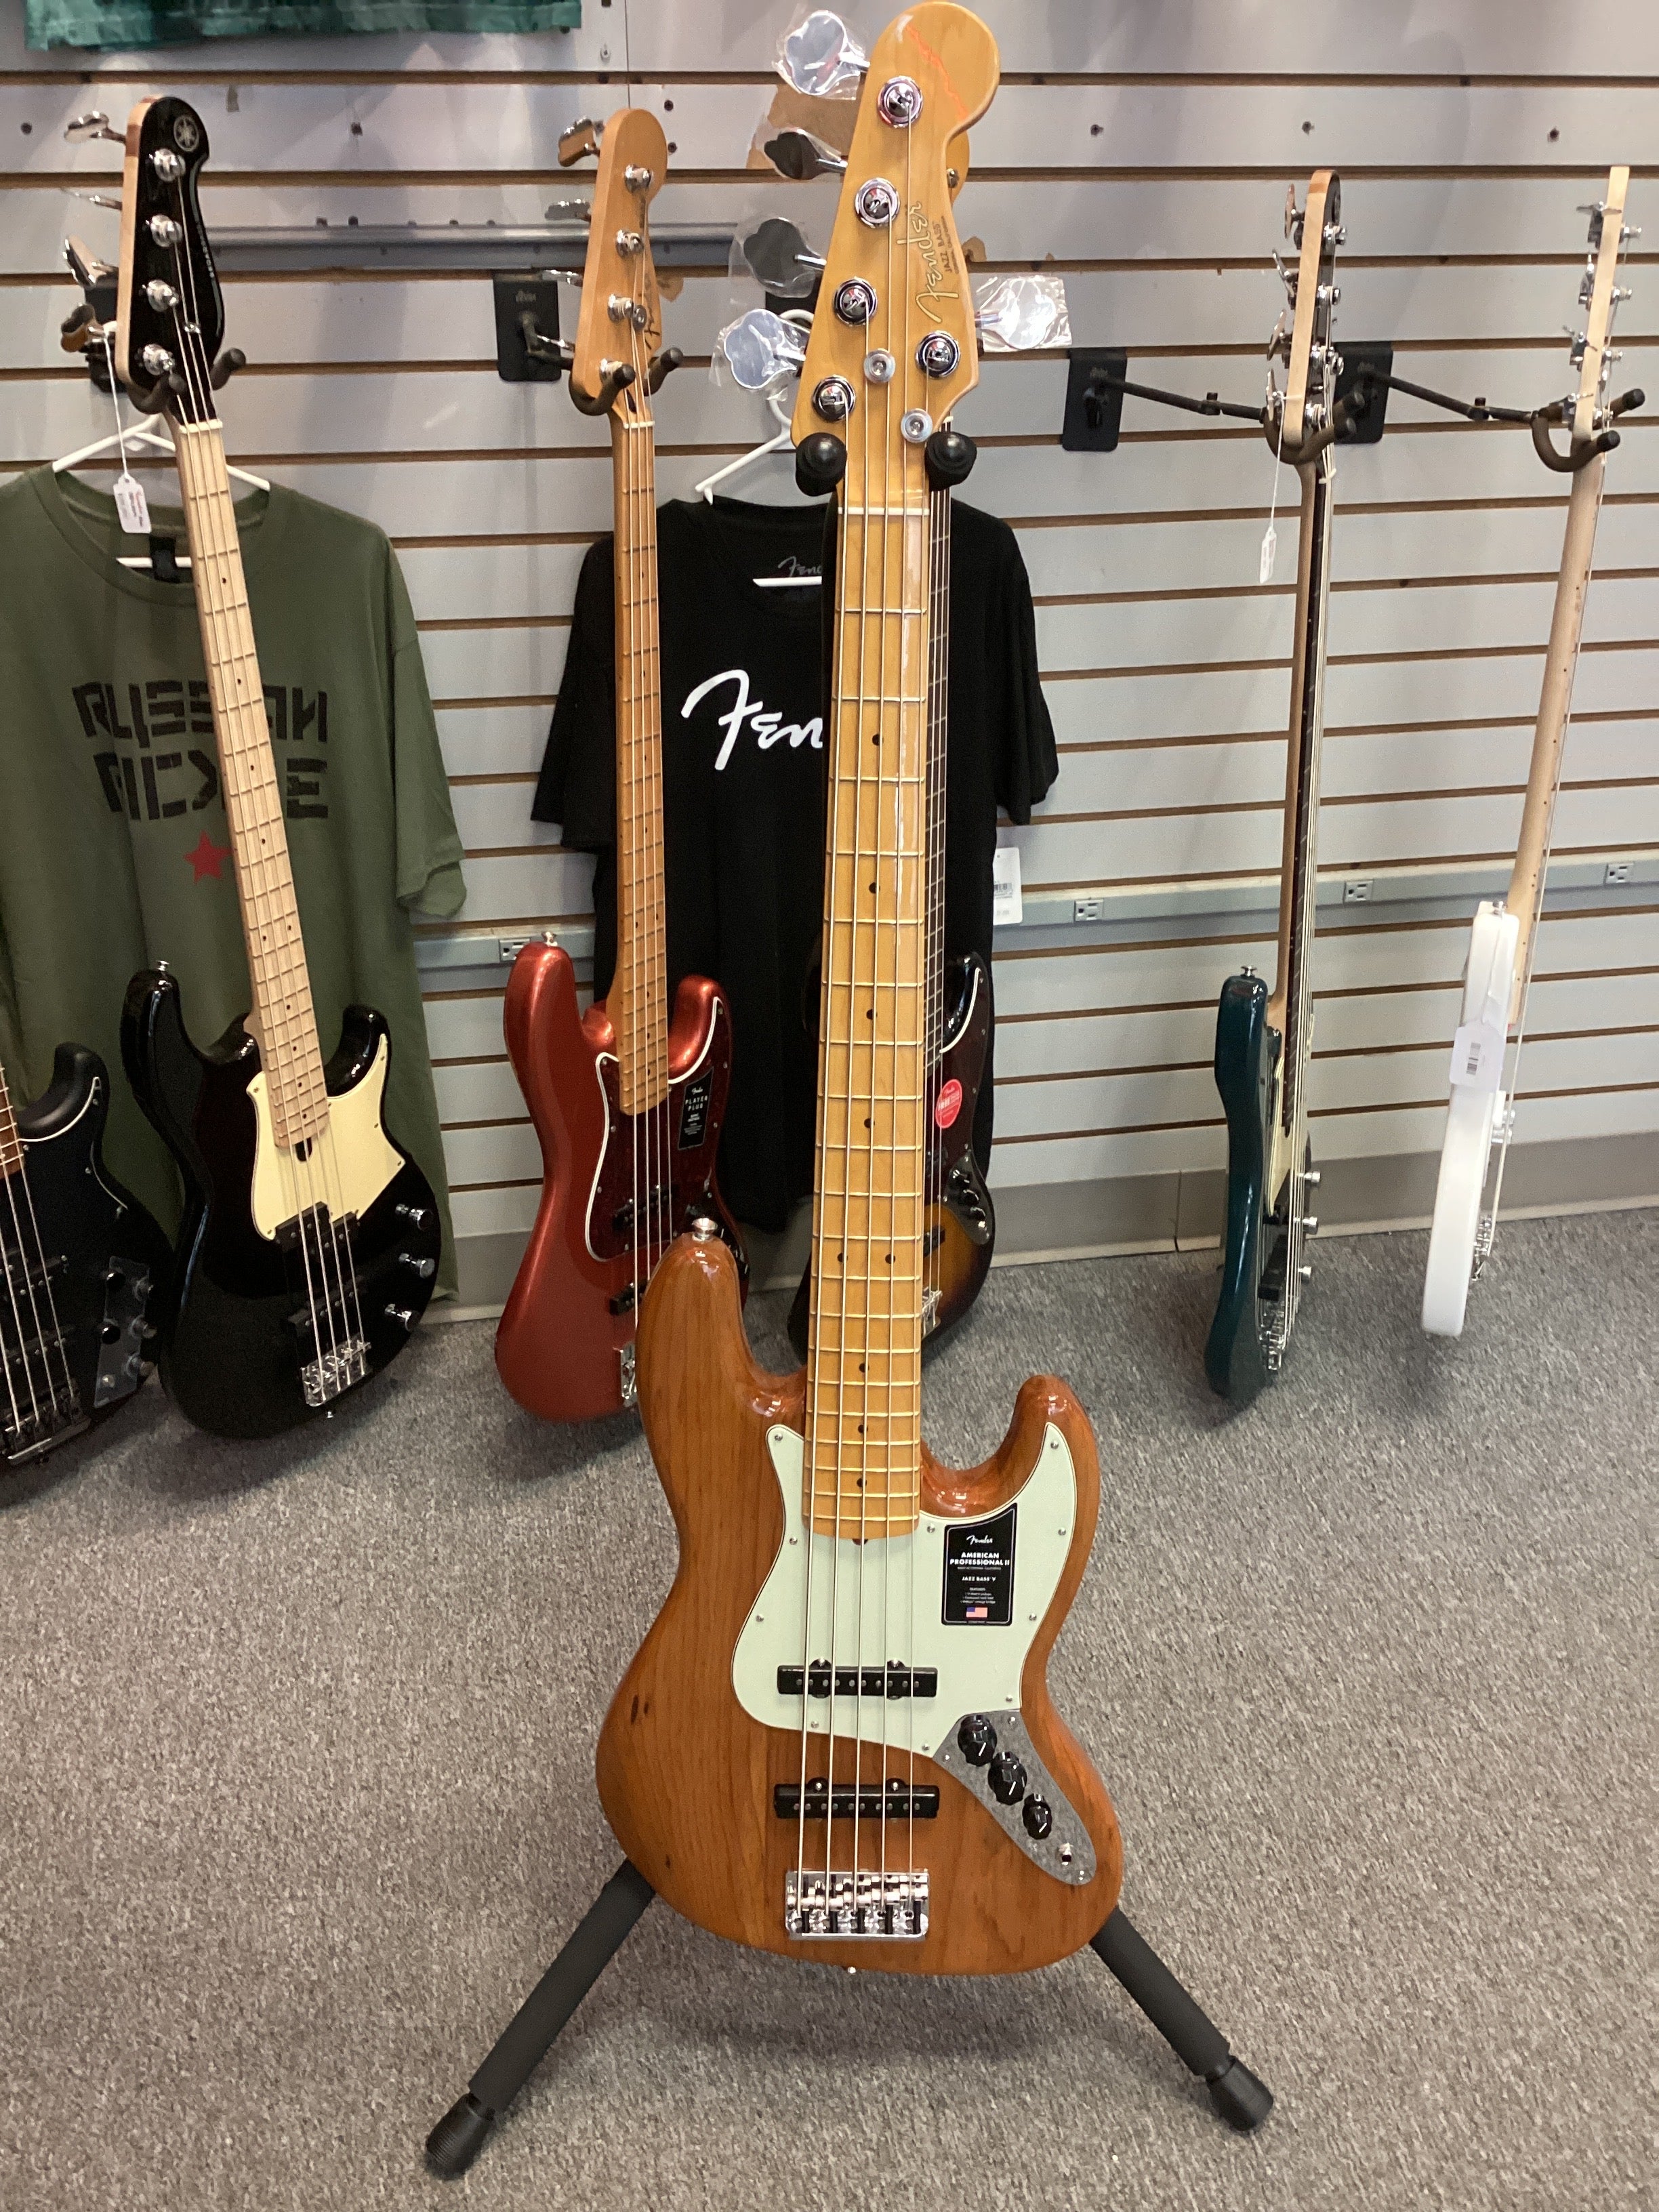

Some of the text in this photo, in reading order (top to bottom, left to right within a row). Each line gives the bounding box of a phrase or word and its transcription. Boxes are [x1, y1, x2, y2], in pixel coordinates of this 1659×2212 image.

[897, 201, 959, 323] Fender
[681, 669, 823, 771] Fen
[966, 1534, 993, 1545] Fender
